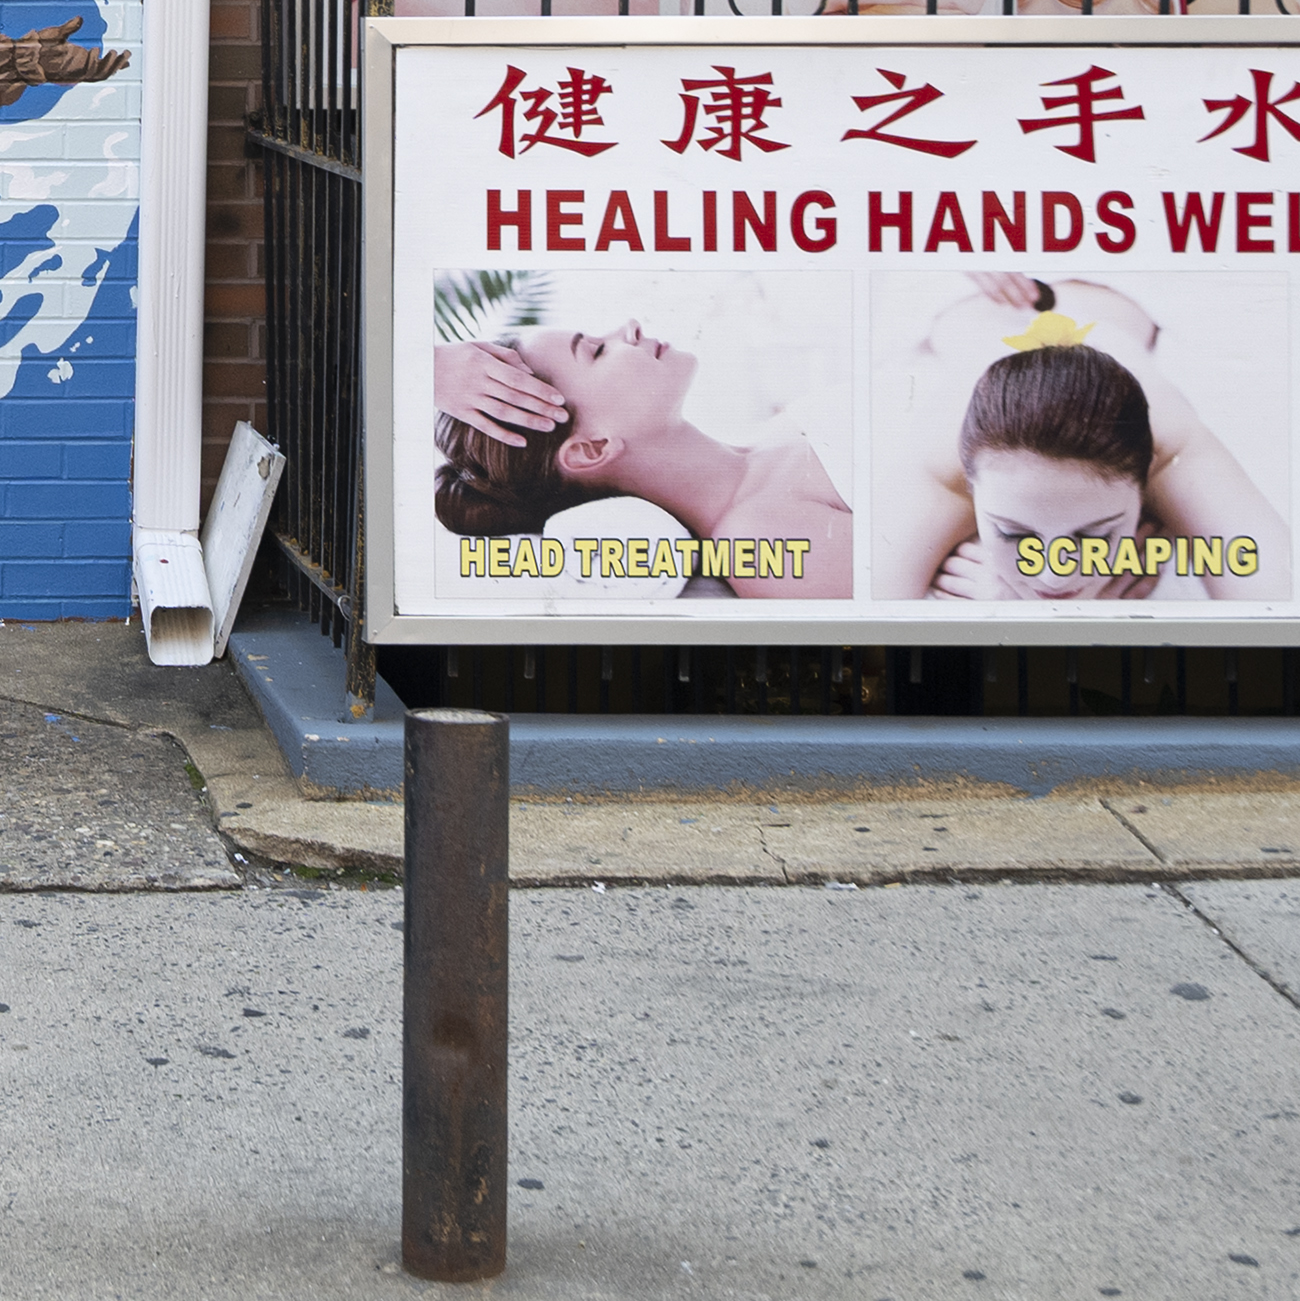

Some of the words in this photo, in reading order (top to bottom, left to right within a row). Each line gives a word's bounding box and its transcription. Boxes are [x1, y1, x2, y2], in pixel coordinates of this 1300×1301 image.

[473, 64, 1300, 164] 健康之手水
[487, 190, 837, 253] HEALING
[868, 191, 1137, 253] HANDS
[460, 538, 565, 578] HEAD
[574, 538, 811, 579] TREATMENT
[1016, 536, 1260, 577] SCRAPING
